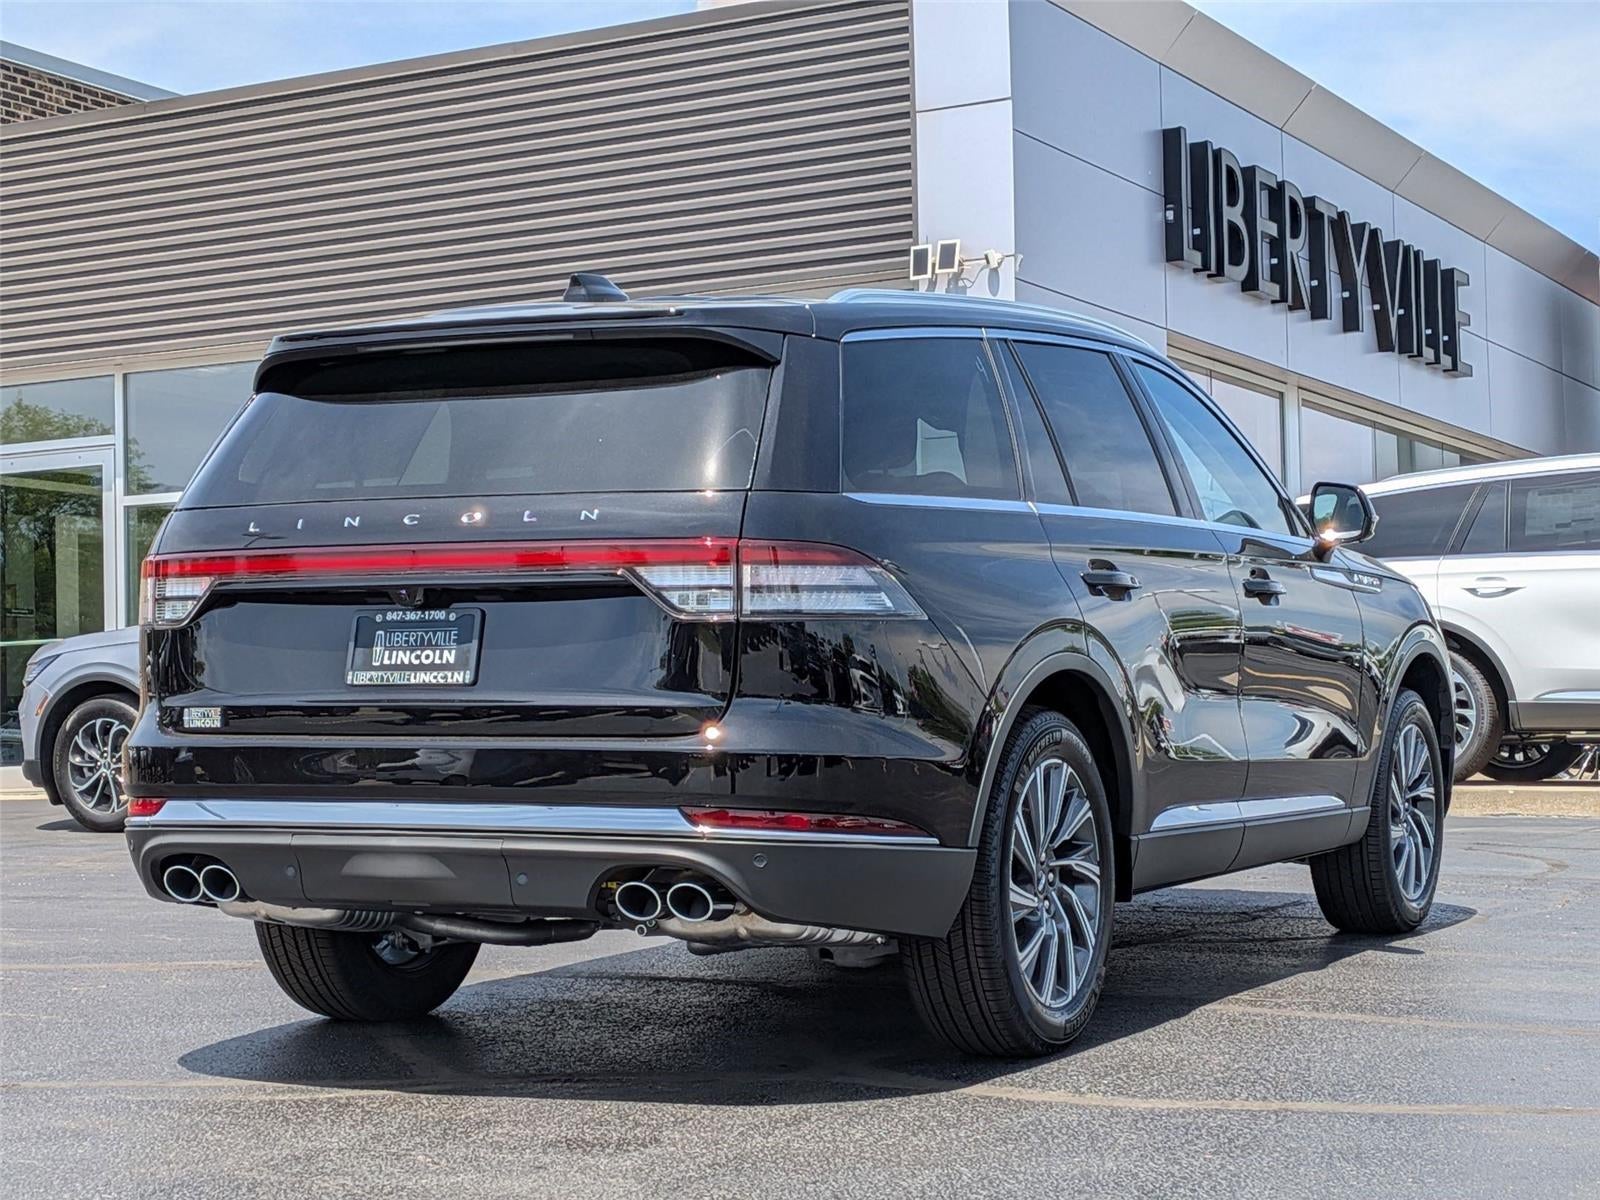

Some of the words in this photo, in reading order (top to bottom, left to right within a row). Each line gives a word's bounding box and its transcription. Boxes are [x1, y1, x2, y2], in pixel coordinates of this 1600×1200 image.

[1163, 126, 1473, 378] LIBERTYVILLE
[249, 508, 600, 533] LINCOLN
[386, 611, 446, 620] 847-367-1700
[386, 630, 458, 647] LIBERTYVILLE
[382, 649, 456, 665] LINCOLN
